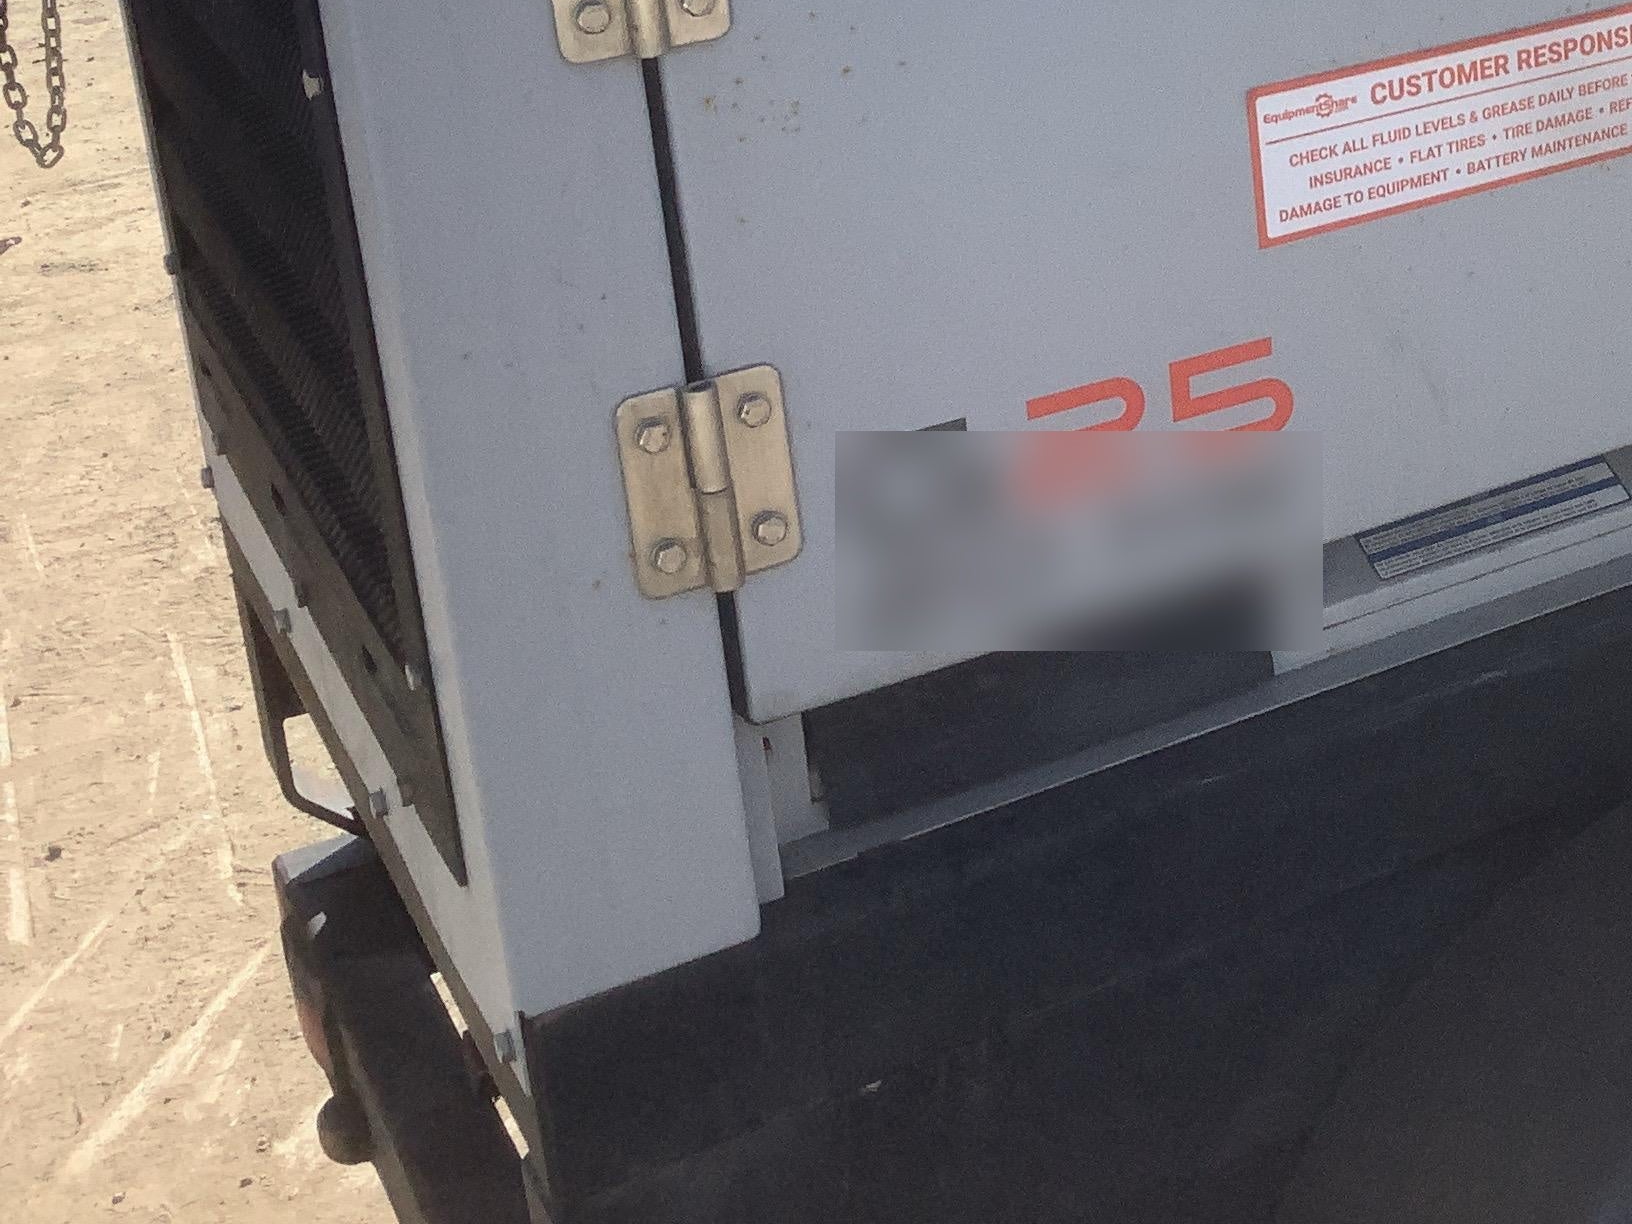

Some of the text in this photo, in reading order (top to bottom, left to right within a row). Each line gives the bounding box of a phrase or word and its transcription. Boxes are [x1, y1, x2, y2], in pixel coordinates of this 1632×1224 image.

[1289, 143, 1339, 167] CHECK
[1342, 136, 1369, 155] ALL
[1372, 126, 1411, 148] FLUID
[1415, 113, 1466, 136] LEVELS
[1469, 110, 1478, 123] &
[1482, 96, 1535, 120] GREASE
[1538, 87, 1575, 107] DAILY
[1578, 73, 1628, 97] BEFORE
[1370, 54, 1510, 105] CUSTOMER
[1279, 195, 1342, 222] DAMAGE
[1344, 190, 1364, 205] TO
[1368, 167, 1450, 200] EQUIPMENT
[1467, 147, 1528, 175] BATTERY
[1531, 123, 1628, 160] MAINTENANCE
[1309, 157, 1392, 189] INSURANCE
[1410, 144, 1444, 164] FLAT
[1446, 133, 1486, 155] TIRES
[1503, 122, 1533, 140] TIRE
[1536, 107, 1593, 132] DAMAGE
